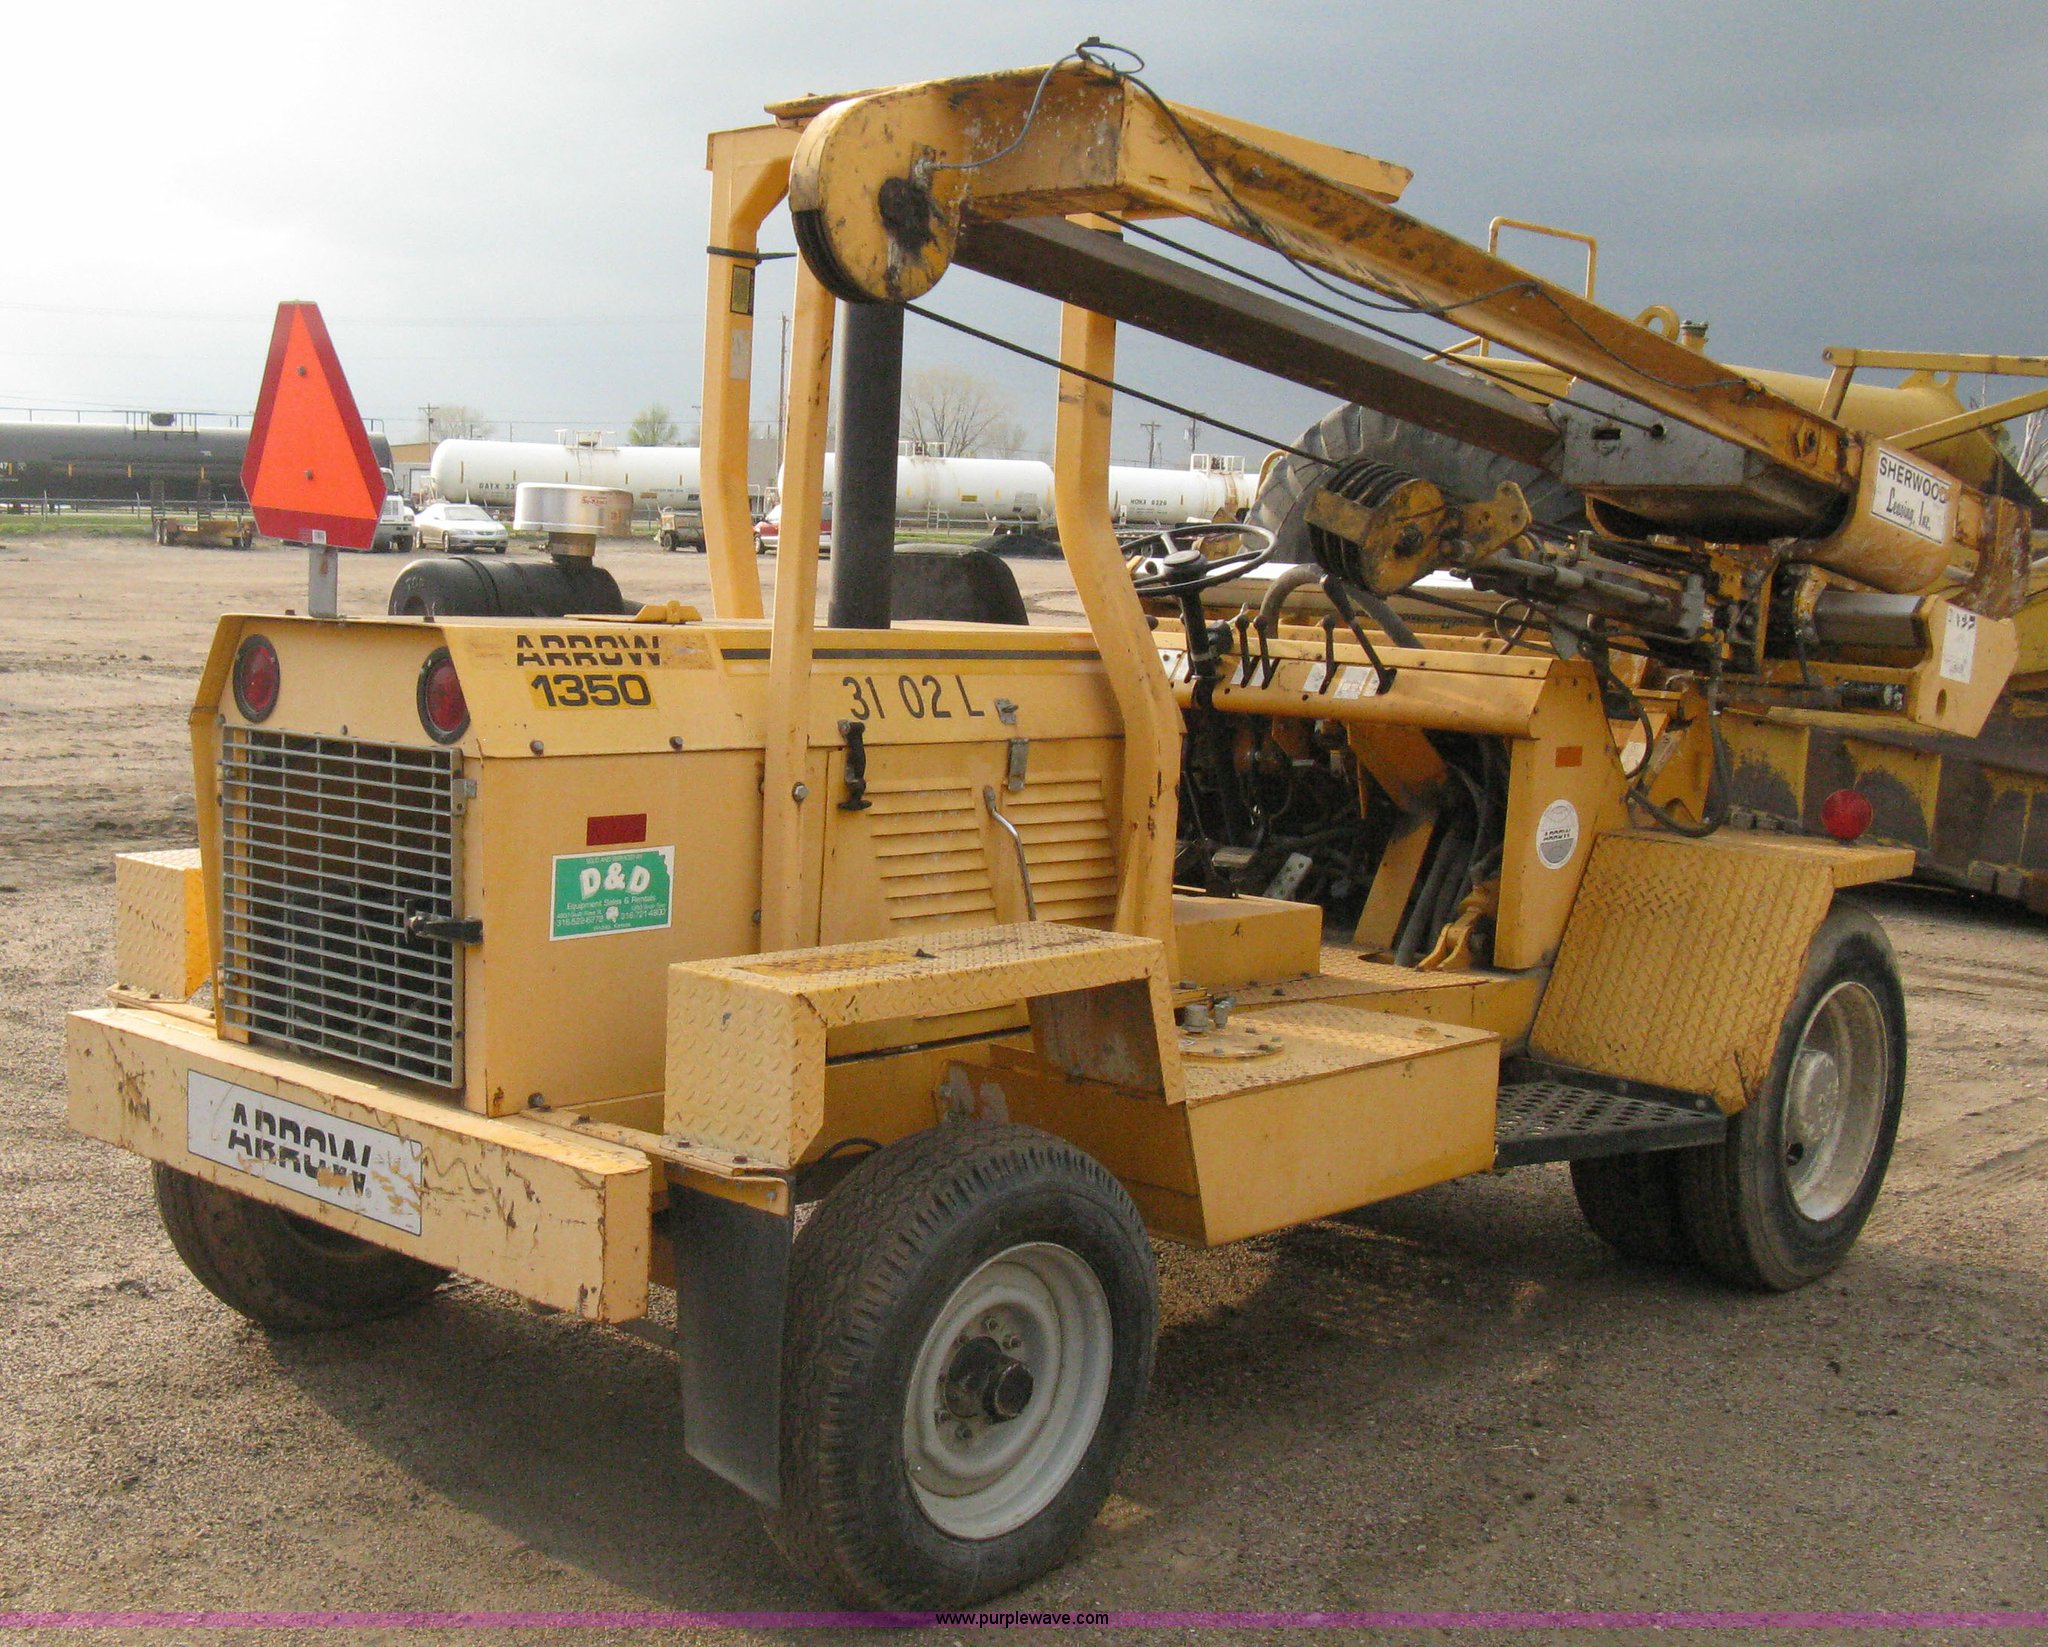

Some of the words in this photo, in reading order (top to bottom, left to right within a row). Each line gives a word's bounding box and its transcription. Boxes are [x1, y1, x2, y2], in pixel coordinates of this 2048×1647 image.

[516, 634, 661, 667] ARROW
[530, 673, 652, 708] 1350
[228, 1102, 372, 1196] ARROW
